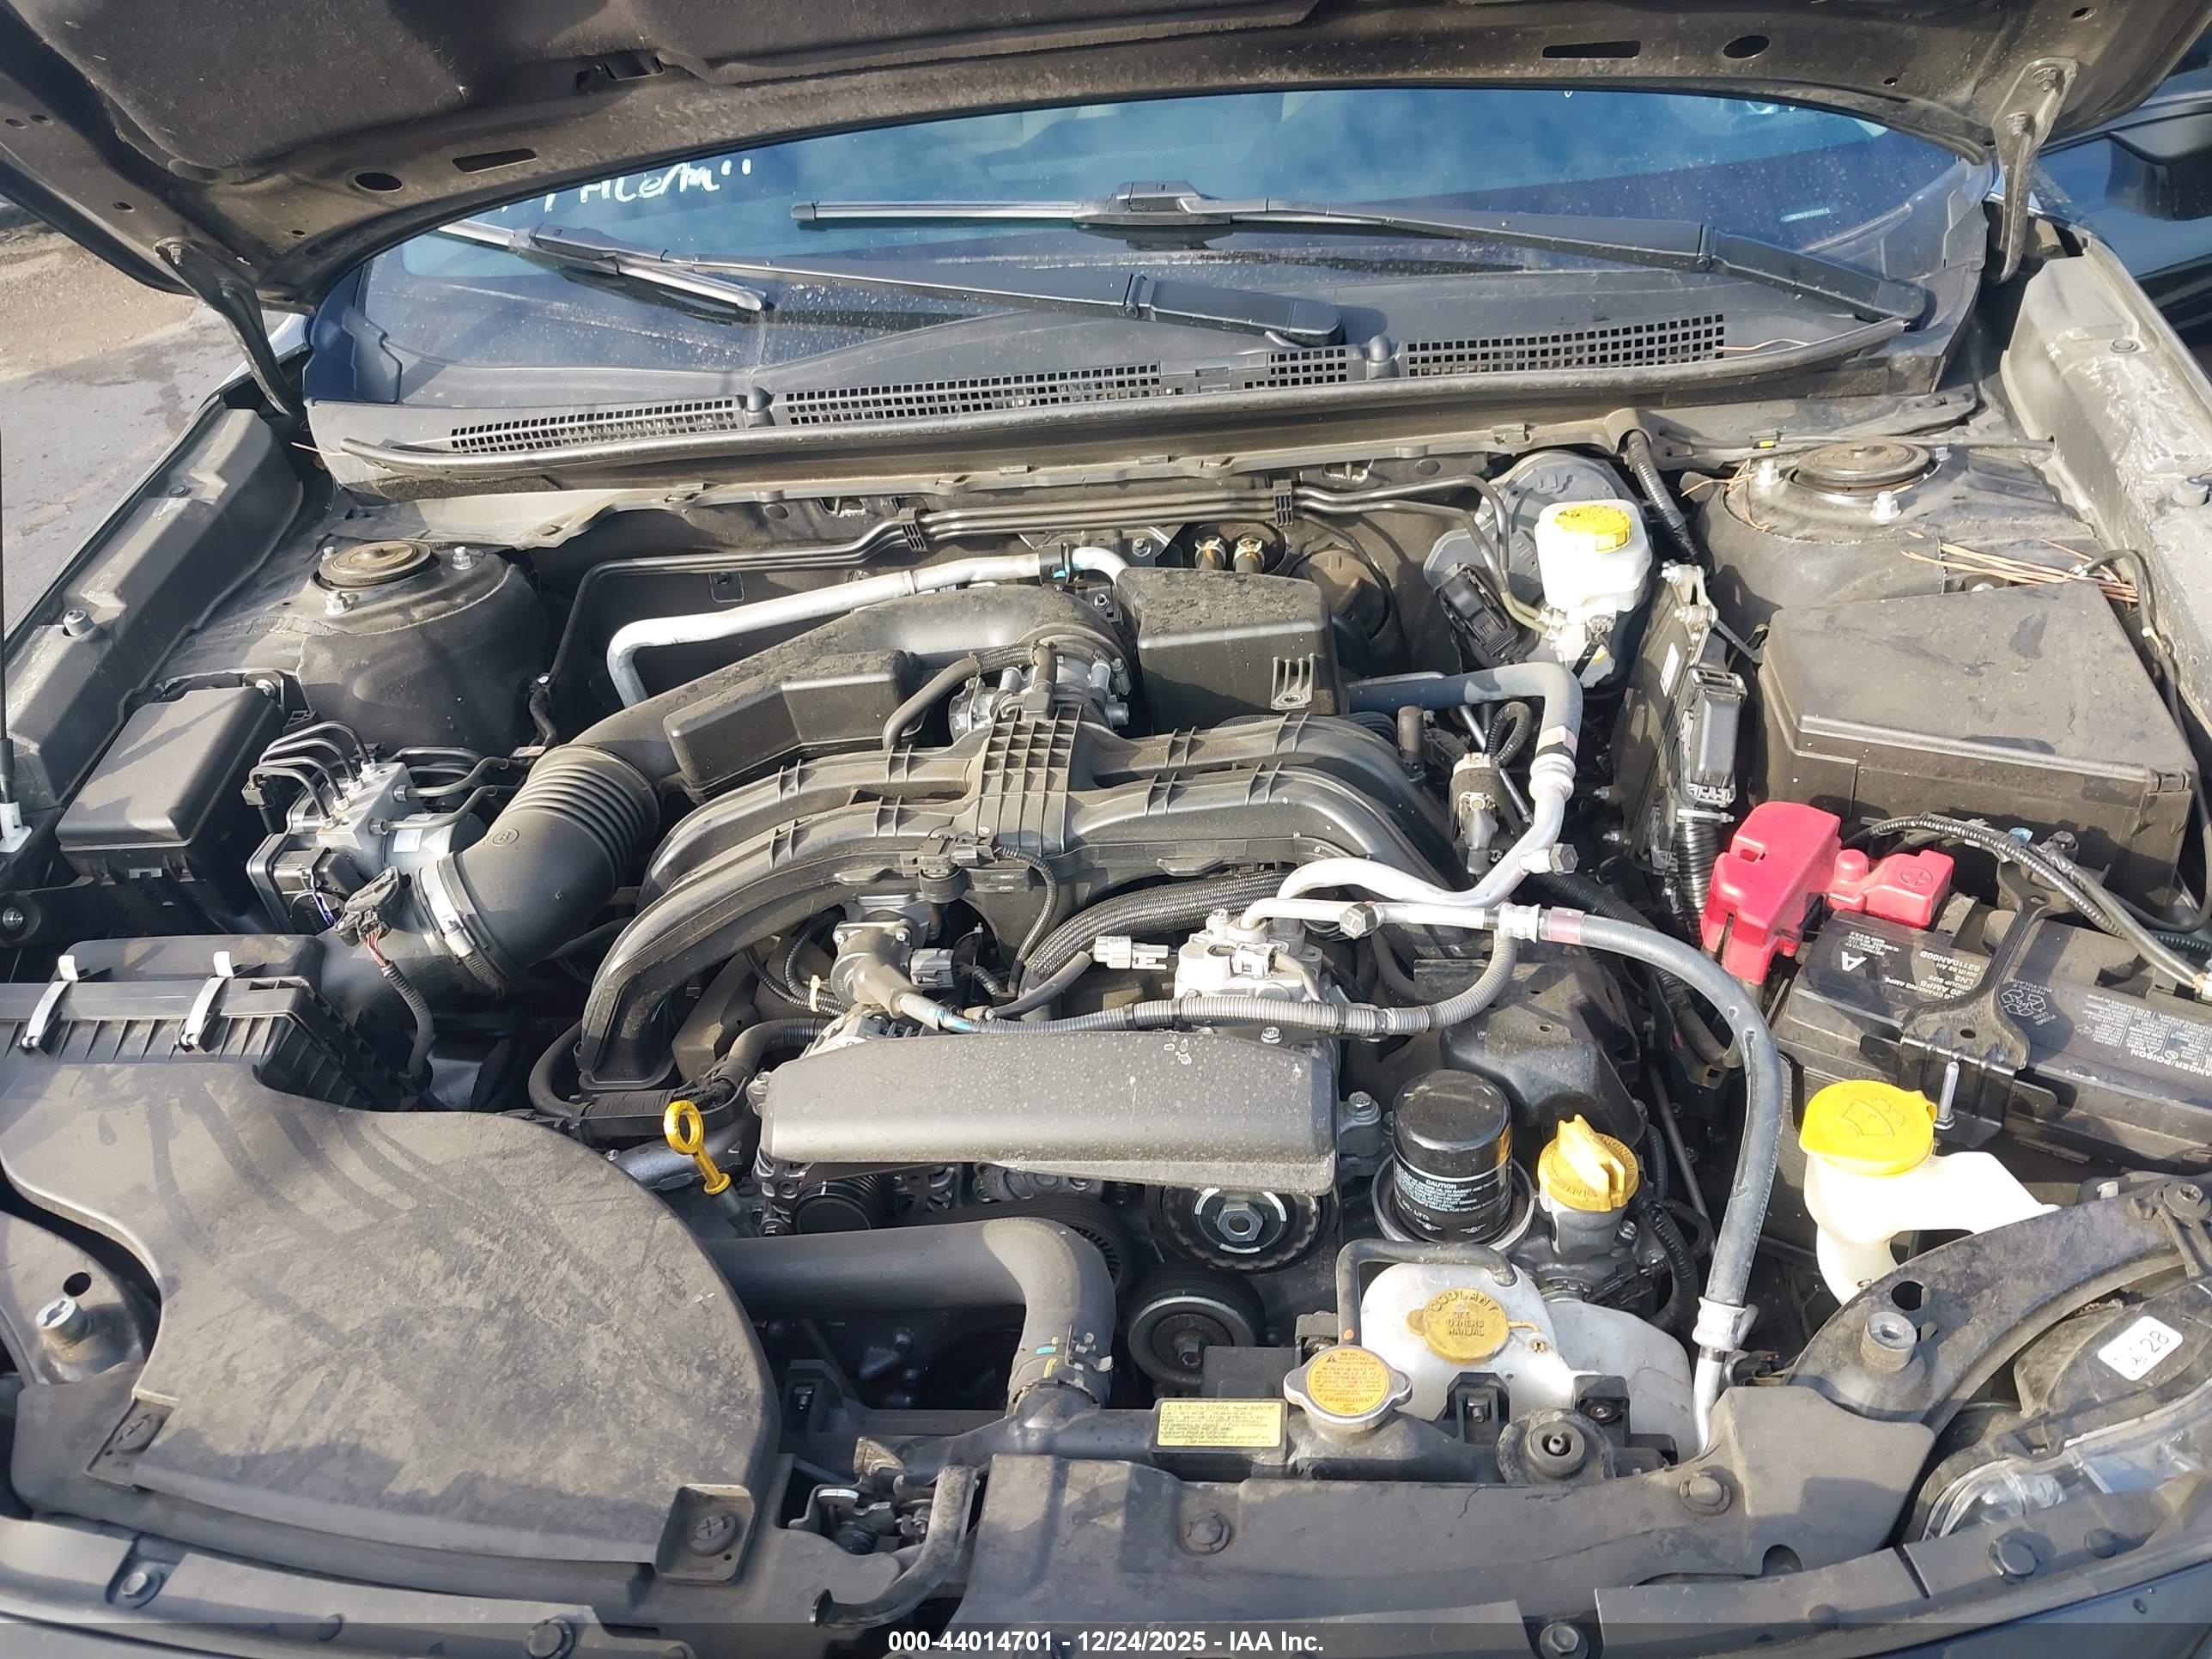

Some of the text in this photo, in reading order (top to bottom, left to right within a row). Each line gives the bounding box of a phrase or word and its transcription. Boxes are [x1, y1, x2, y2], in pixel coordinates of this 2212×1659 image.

[1919, 980, 1949, 994] AMPS
[2130, 1048, 2212, 1078] ANGER/POISON
[1425, 1179, 1457, 1190] CAUTION
[1430, 1291, 1499, 1312] COOLANT
[1449, 1327, 1485, 1337] MANUAL
[2139, 1330, 2169, 1354] 28
